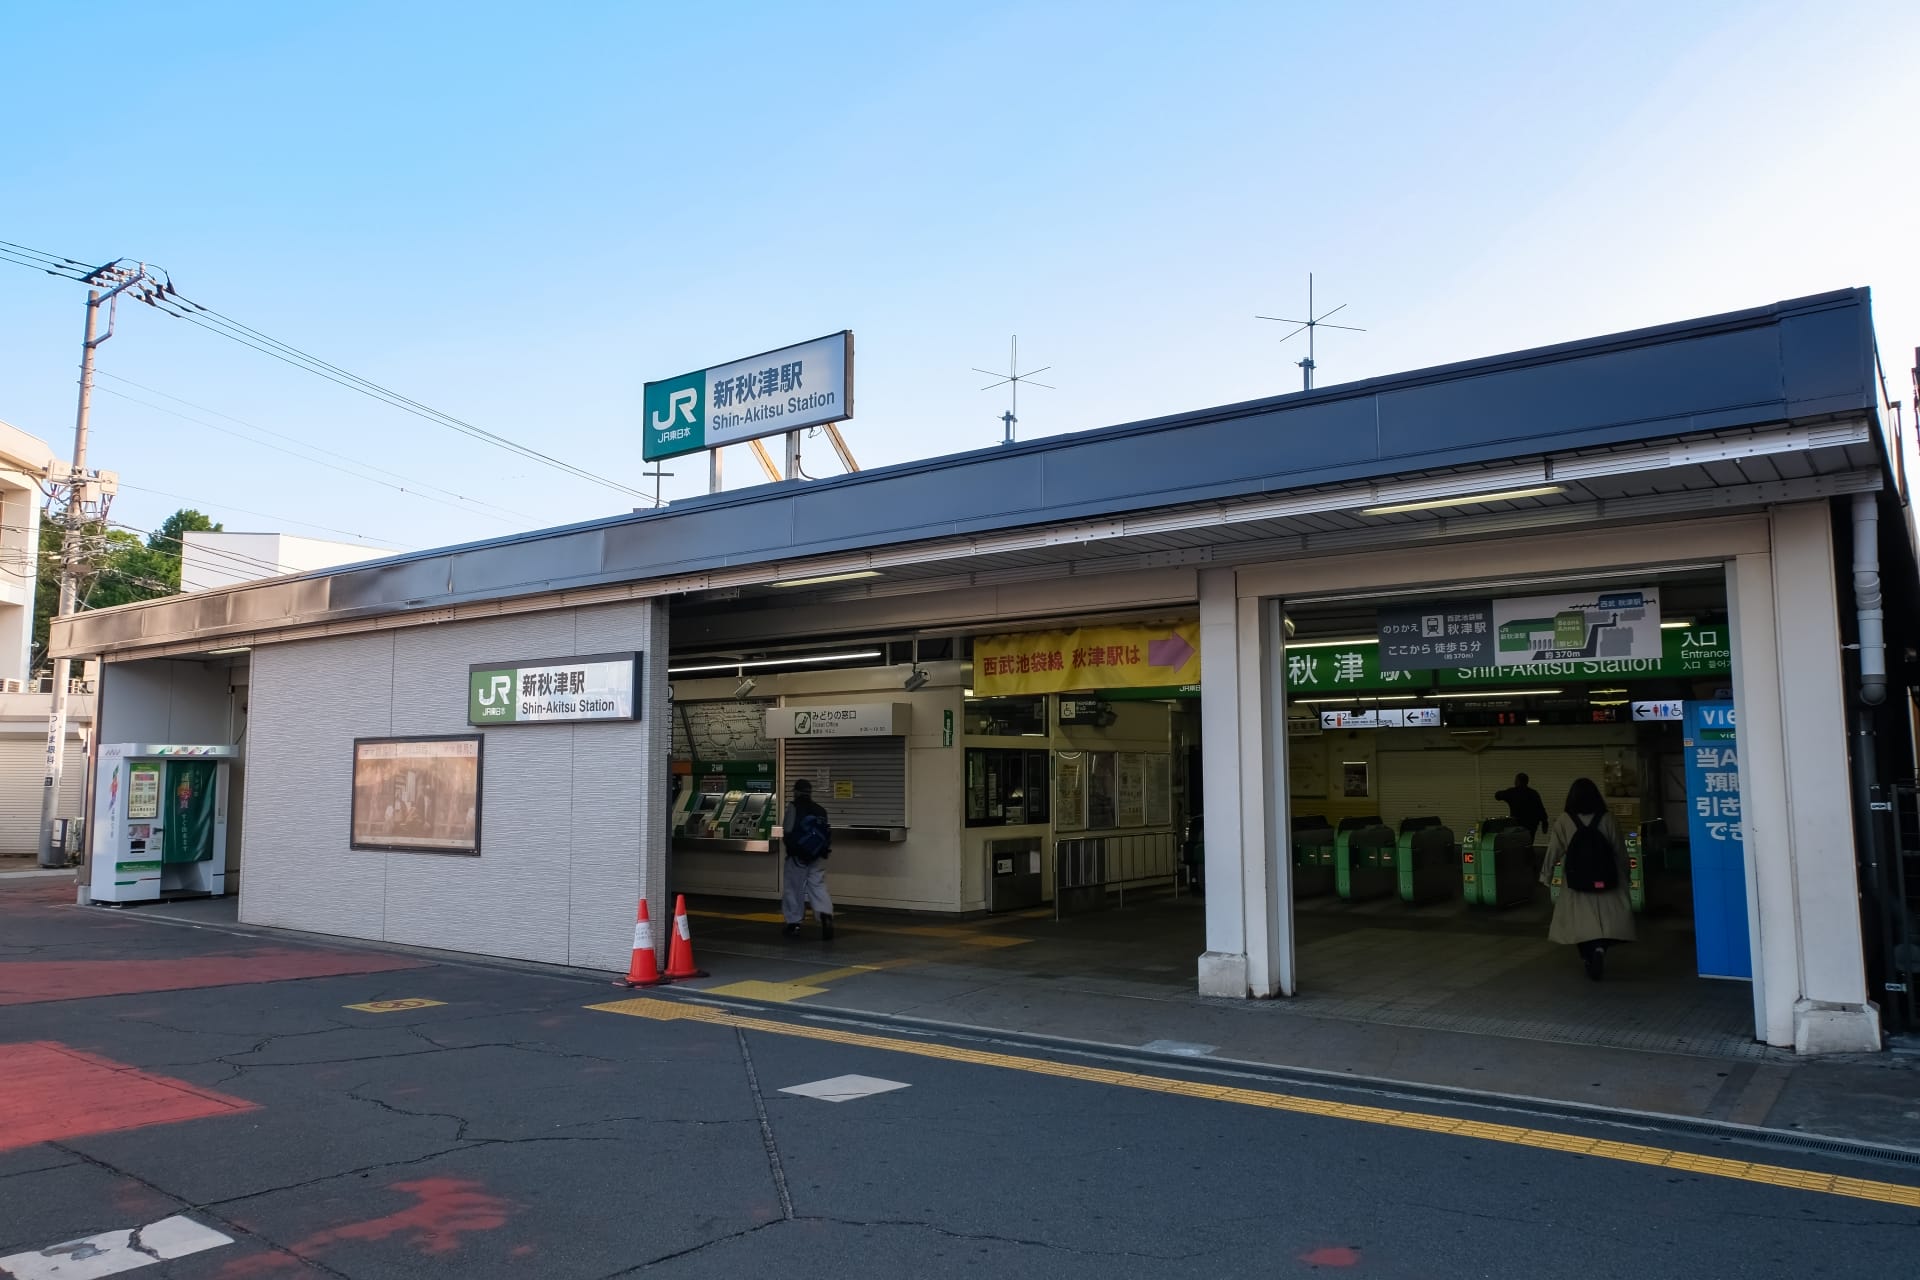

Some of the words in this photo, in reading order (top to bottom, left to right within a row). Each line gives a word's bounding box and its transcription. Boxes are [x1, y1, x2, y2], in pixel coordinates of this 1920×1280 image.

[713, 360, 803, 410] 新秋津駅
[652, 387, 698, 431] JR
[712, 404, 785, 431] Shin-Akitsu
[788, 391, 835, 414] Station
[657, 426, 692, 444] JR東日本
[1383, 623, 1419, 634] のりかえ
[1447, 621, 1487, 635] 秋津駅
[1681, 631, 1717, 647] 入口
[1389, 644, 1431, 656] ここから
[1681, 650, 1729, 659] Entrance
[984, 650, 1065, 677] 西武池袋線
[1071, 645, 1141, 669] 秋津駅は
[1683, 661, 1701, 670] 入口
[478, 676, 511, 706] JR
[522, 671, 585, 697] 新秋津駅
[522, 701, 576, 715] Shin-Akitsu
[579, 699, 615, 713] Station
[812, 711, 857, 720] みどりの窓口
[1696, 796, 1740, 817] 引き
